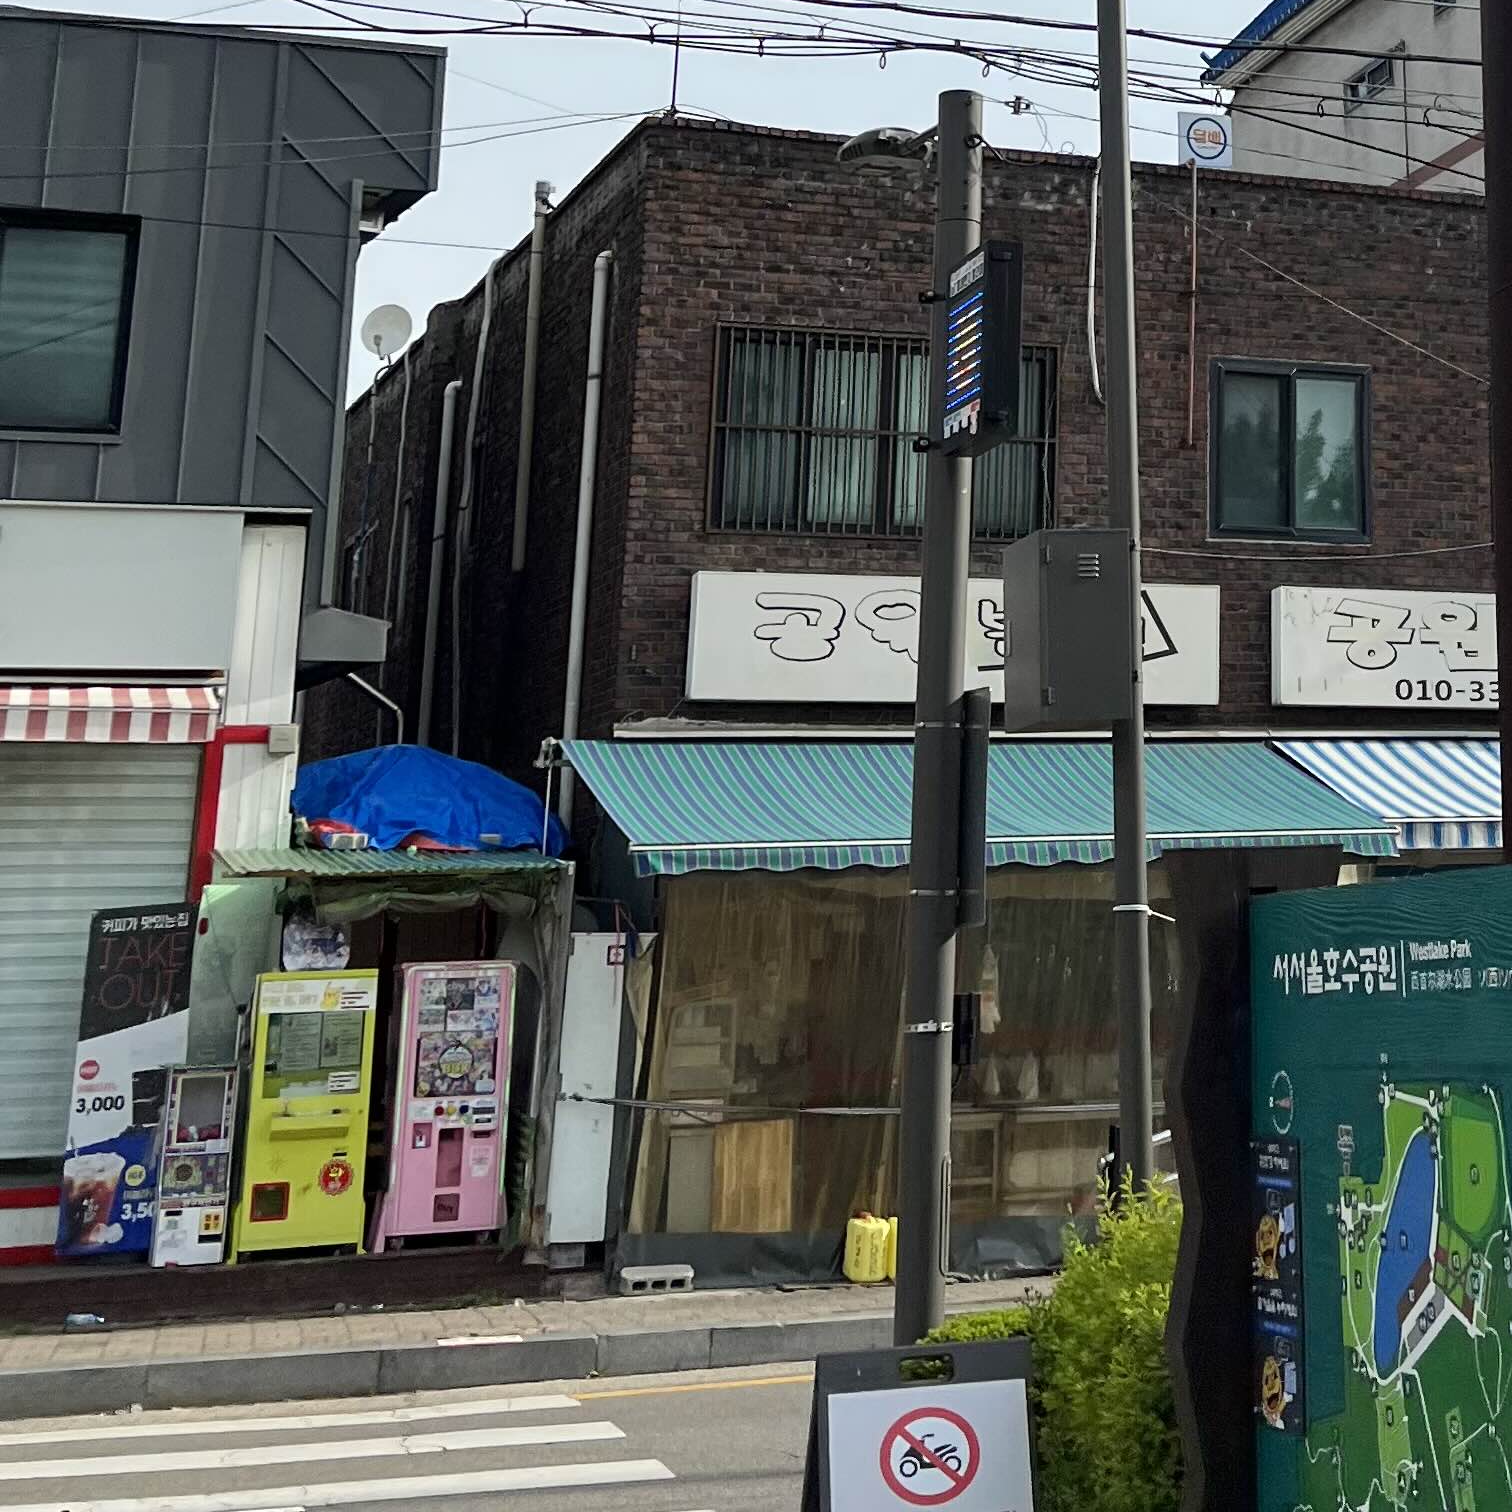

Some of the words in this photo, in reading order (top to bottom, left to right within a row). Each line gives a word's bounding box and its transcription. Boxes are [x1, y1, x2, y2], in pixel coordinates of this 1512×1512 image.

[101, 917, 138, 933] 커피가
[99, 931, 190, 970] TAKE
[1408, 940, 1450, 961] Westlake
[1450, 939, 1473, 959] Park
[1273, 945, 1397, 995] 서서울호수공원
[99, 968, 180, 1010] OUT
[75, 1094, 126, 1116] 3,000
